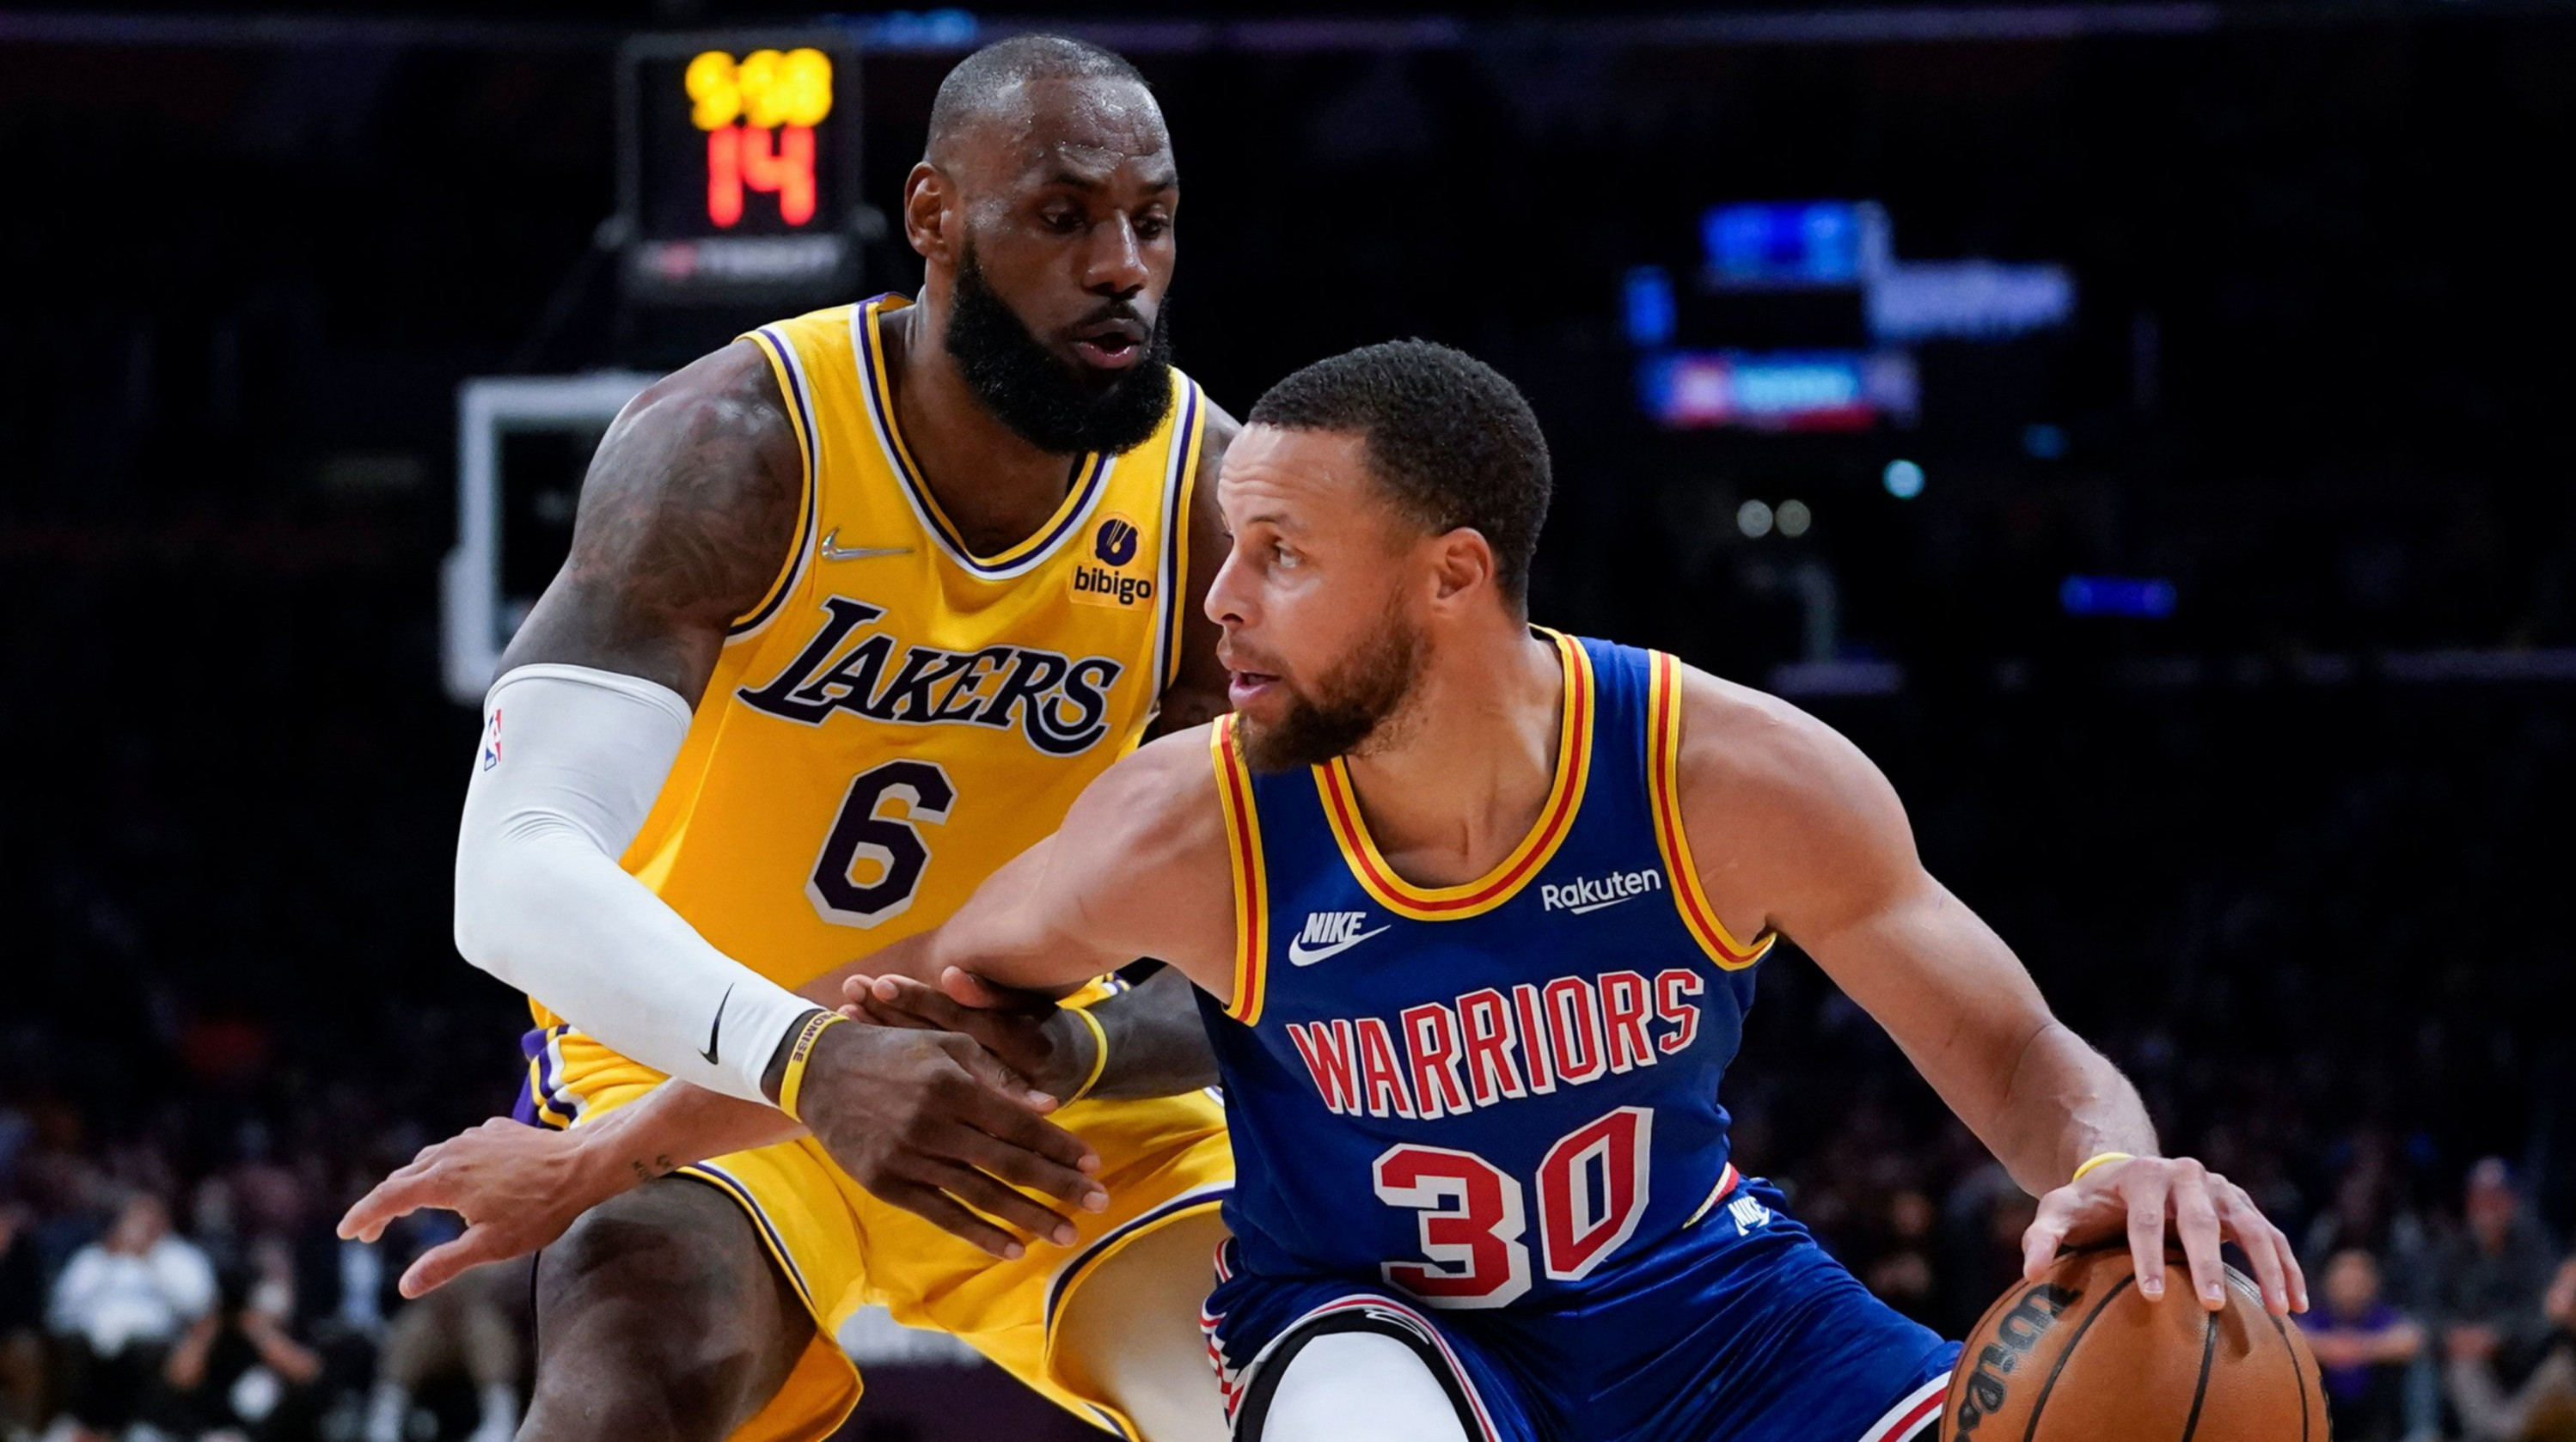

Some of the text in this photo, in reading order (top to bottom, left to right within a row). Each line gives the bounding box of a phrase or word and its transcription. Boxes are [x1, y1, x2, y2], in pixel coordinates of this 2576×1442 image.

[707, 124, 816, 228] 14
[1074, 565, 1152, 605] bibigo
[734, 593, 1124, 756] LAKERS
[805, 758, 958, 930] 6
[1541, 869, 1661, 912] Rakuten
[1300, 911, 1367, 944] NIKE
[1286, 968, 1704, 1120] WARRIORS
[1373, 1105, 1654, 1310] 30
